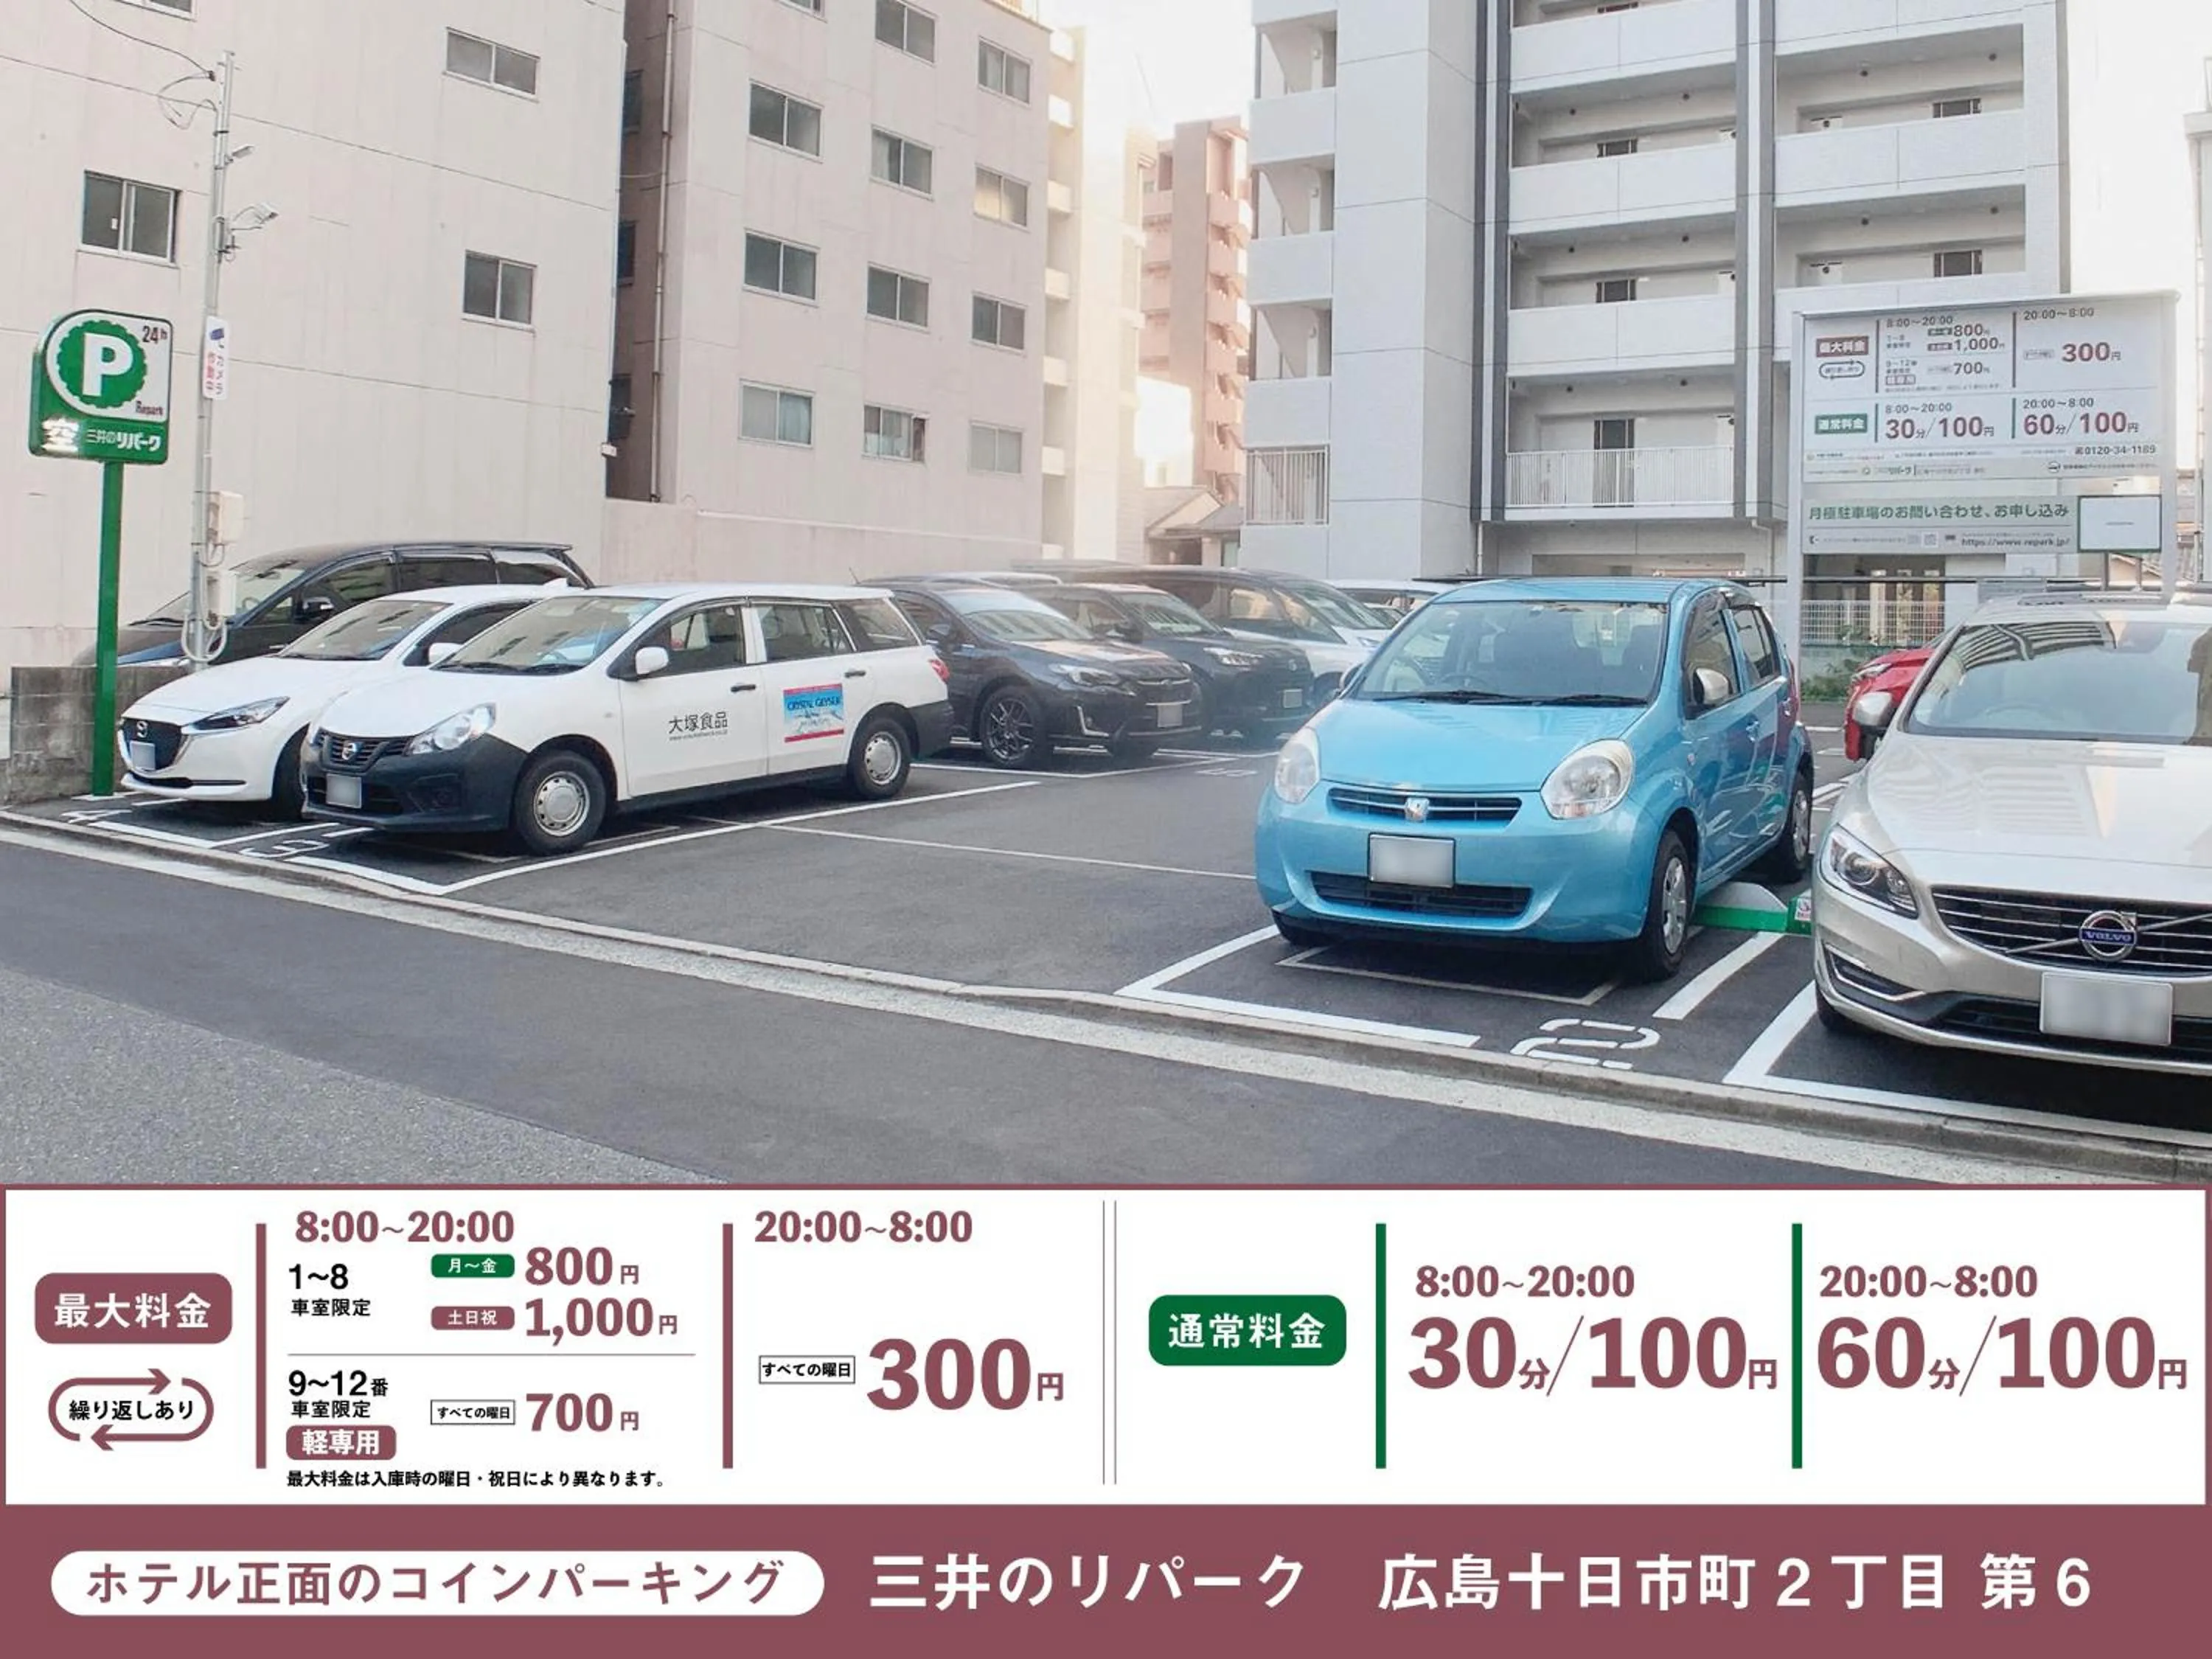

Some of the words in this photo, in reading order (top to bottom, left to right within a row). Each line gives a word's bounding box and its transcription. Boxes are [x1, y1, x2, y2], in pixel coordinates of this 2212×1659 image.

[83, 333, 133, 396] P
[669, 711, 728, 734] 大塚食品
[2085, 931, 2132, 942] VOLVO
